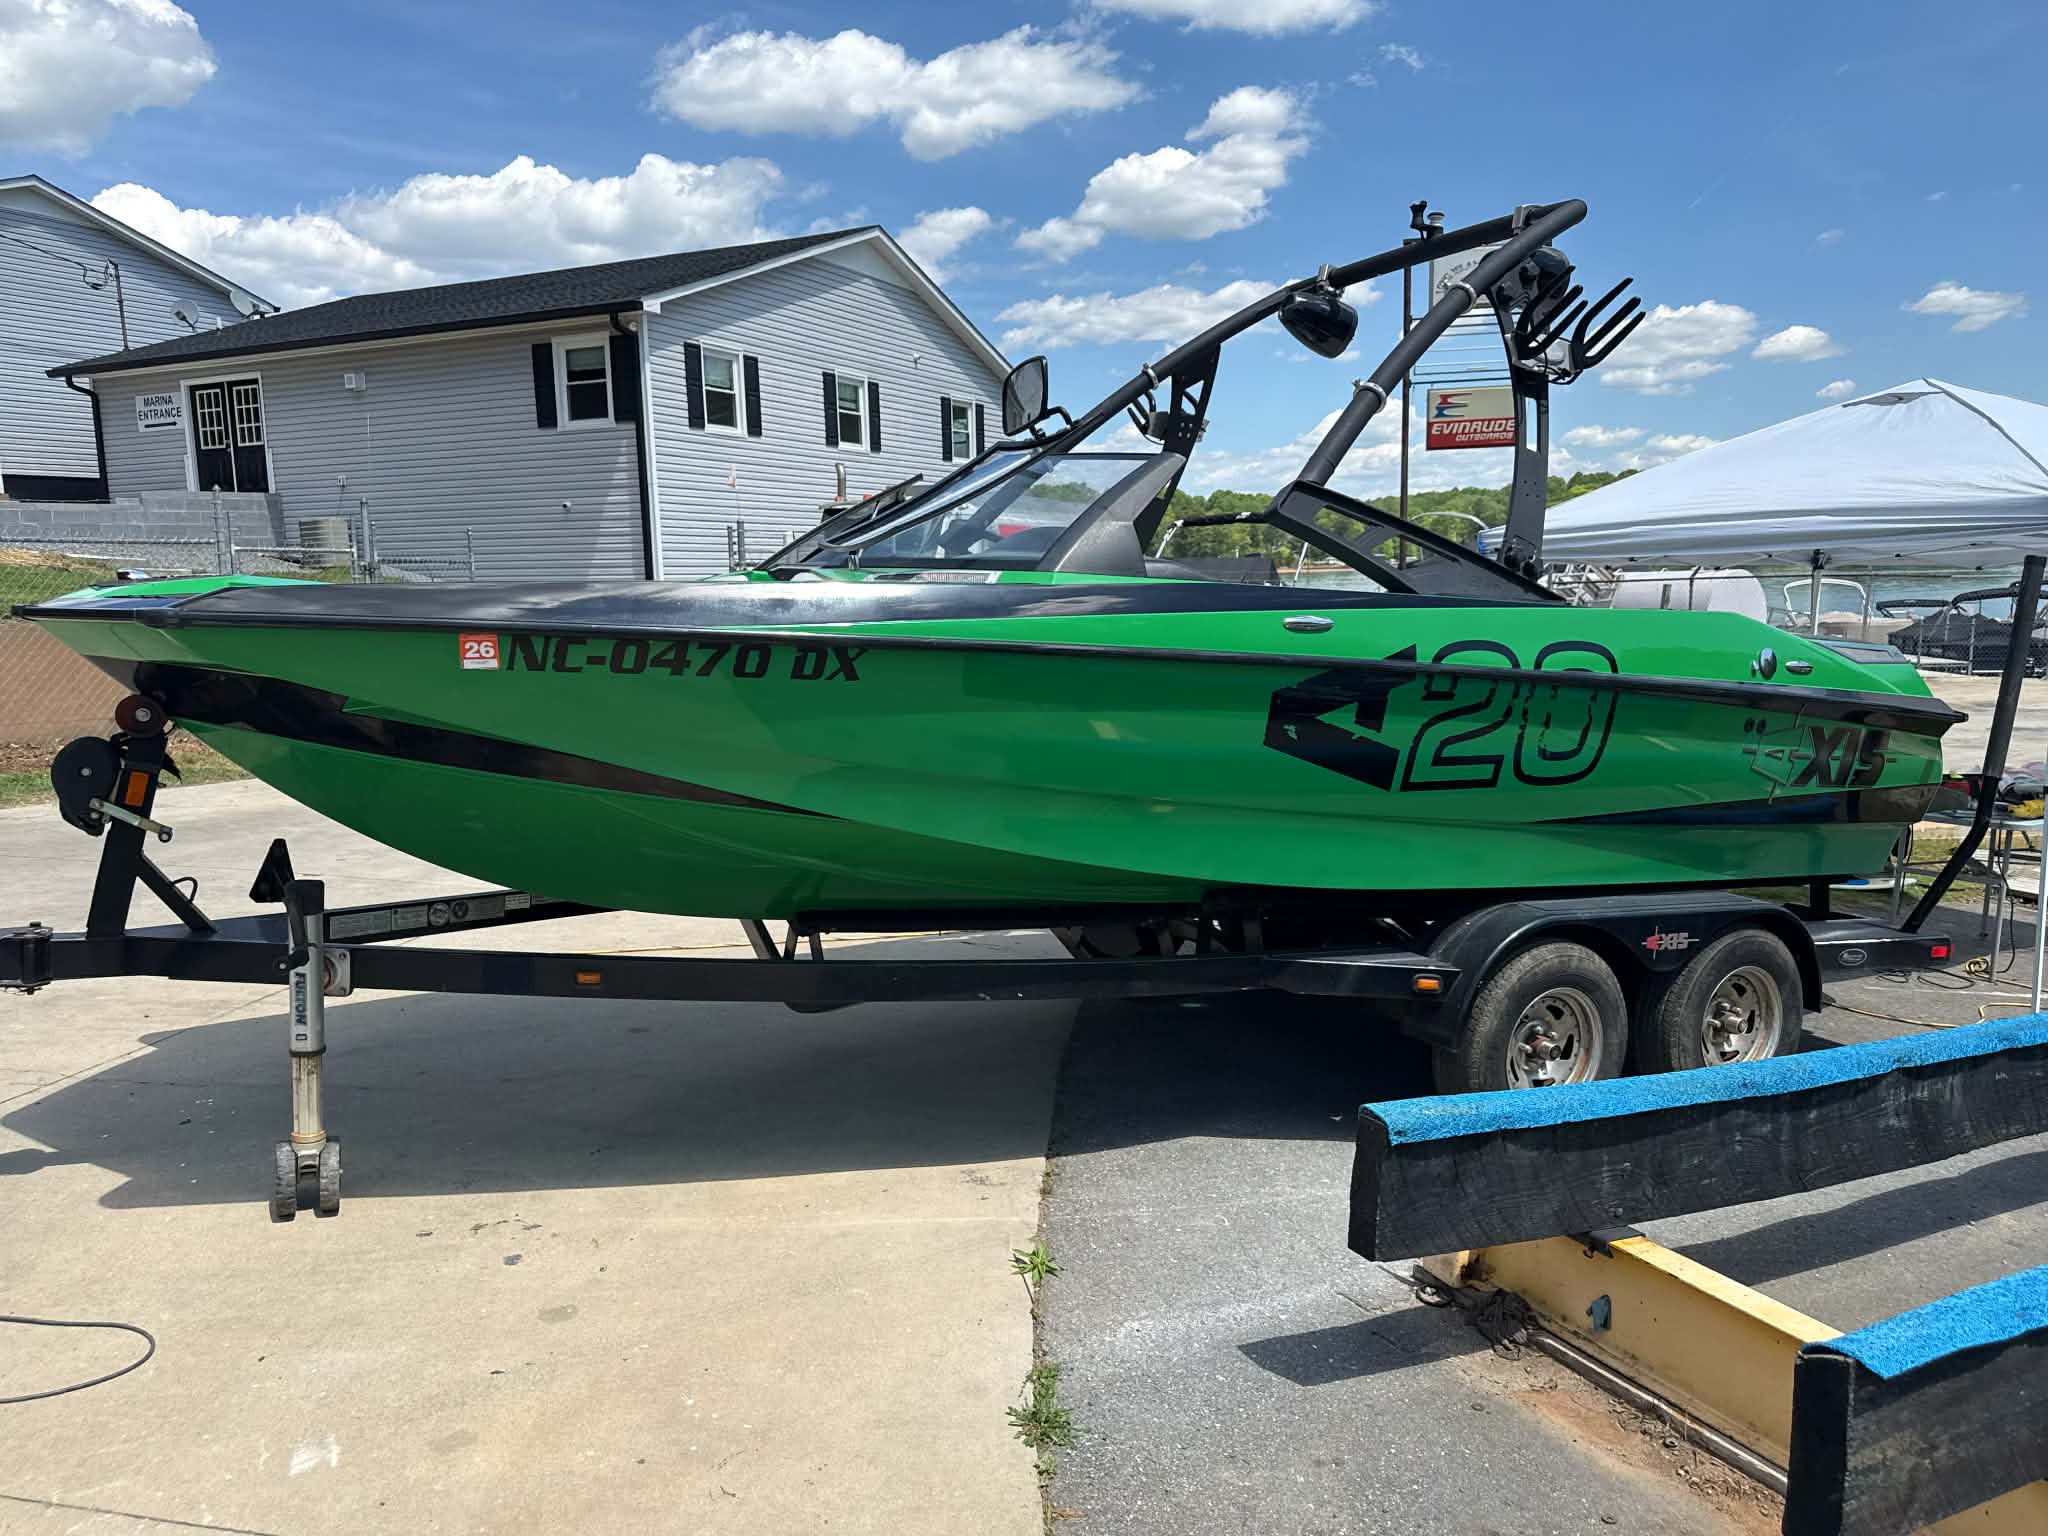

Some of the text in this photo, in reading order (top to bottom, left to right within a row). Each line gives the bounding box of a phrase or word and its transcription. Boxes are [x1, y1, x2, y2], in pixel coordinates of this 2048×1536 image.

[143, 395, 174, 407] MARINA
[138, 406, 182, 421] ENTRANCE
[464, 641, 495, 658] 26
[790, 646, 868, 680] DX
